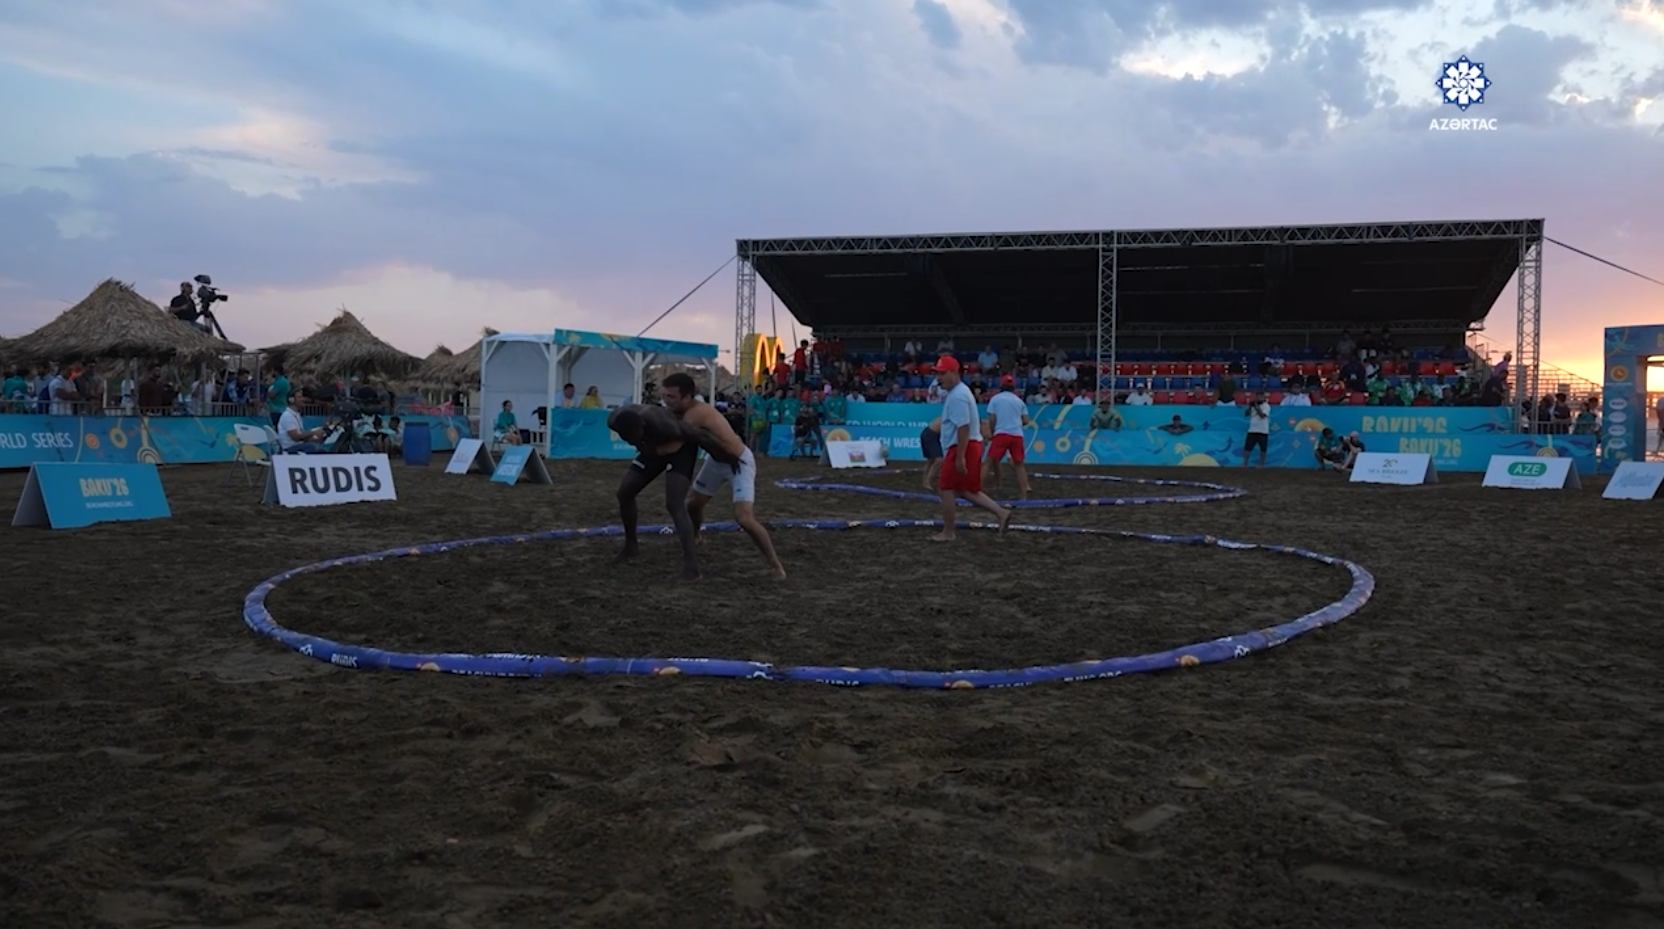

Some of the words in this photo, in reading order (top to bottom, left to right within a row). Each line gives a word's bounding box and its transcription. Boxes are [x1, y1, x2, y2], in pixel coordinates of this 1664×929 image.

[31, 432, 74, 448] SERIES
[1513, 463, 1542, 476] AZE
[79, 477, 130, 498] BAKU'26
[288, 465, 381, 494] RUDIS
